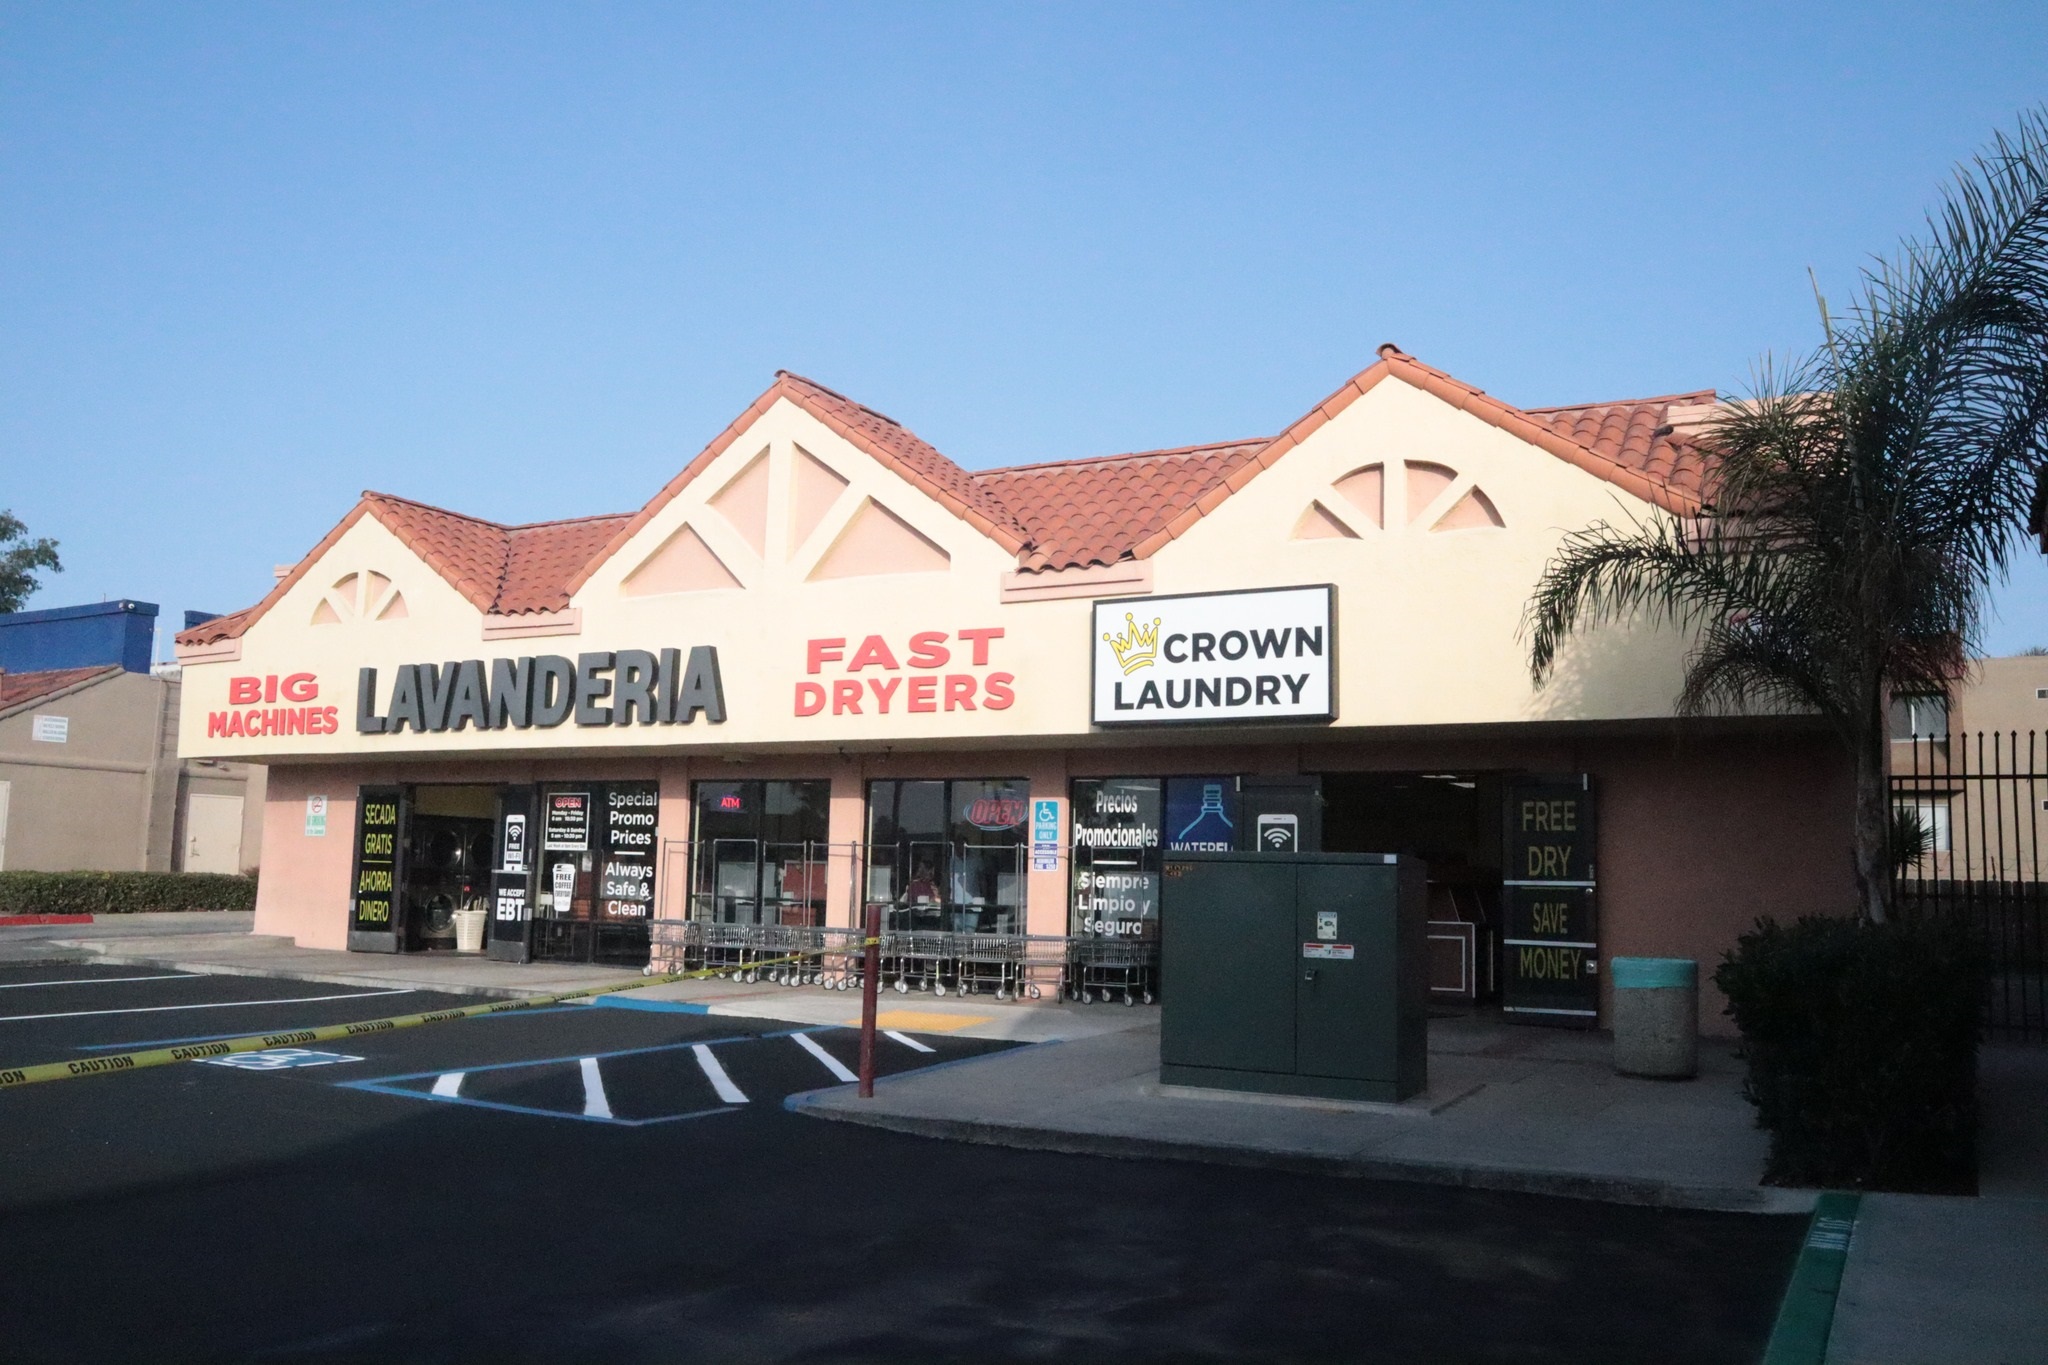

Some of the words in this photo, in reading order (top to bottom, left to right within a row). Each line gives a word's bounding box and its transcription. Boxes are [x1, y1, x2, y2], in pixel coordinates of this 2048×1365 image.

[806, 627, 1005, 675] FAST
[1163, 626, 1323, 664] CROWN
[228, 672, 319, 705] BIG
[356, 645, 728, 734] LAVANDERIA
[794, 671, 1016, 718] DRYERS
[1114, 673, 1311, 711] LAUNDRY
[207, 705, 339, 738] MACHINES
[555, 797, 582, 808] OPEN
[608, 791, 657, 809] Special
[721, 797, 741, 809] ATM
[1096, 789, 1138, 813] Precios
[364, 804, 396, 825] SECADA
[609, 810, 654, 826] Promo
[971, 798, 1023, 826] OPEN
[1521, 800, 1577, 832] FREE
[364, 833, 393, 855] GRATIS
[610, 829, 652, 845] Prices
[1075, 822, 1159, 848] Promocionales
[605, 862, 653, 880] Always
[1528, 846, 1572, 877] DRY
[359, 871, 392, 892] AHORRA
[555, 873, 572, 881] FREE
[555, 881, 572, 890] COFFEE
[1080, 871, 1150, 890] Siempre
[498, 888, 507, 897] WE
[507, 889, 526, 898] ACCEPT
[606, 881, 636, 896] Safe
[640, 882, 650, 897] &
[358, 900, 389, 922] DINERO
[496, 898, 525, 922] EBT
[607, 900, 646, 916] Clean
[1078, 894, 1136, 915] Limpio
[1142, 898, 1151, 915] y
[1083, 917, 1143, 937] Seguro
[1532, 902, 1568, 935] SAVE
[1519, 947, 1582, 981] MONEY
[345, 1019, 395, 1035] CAUTION
[262, 1031, 317, 1047] CAUTION
[171, 1042, 231, 1061] CAUTION
[67, 1055, 135, 1075] CAUTION
